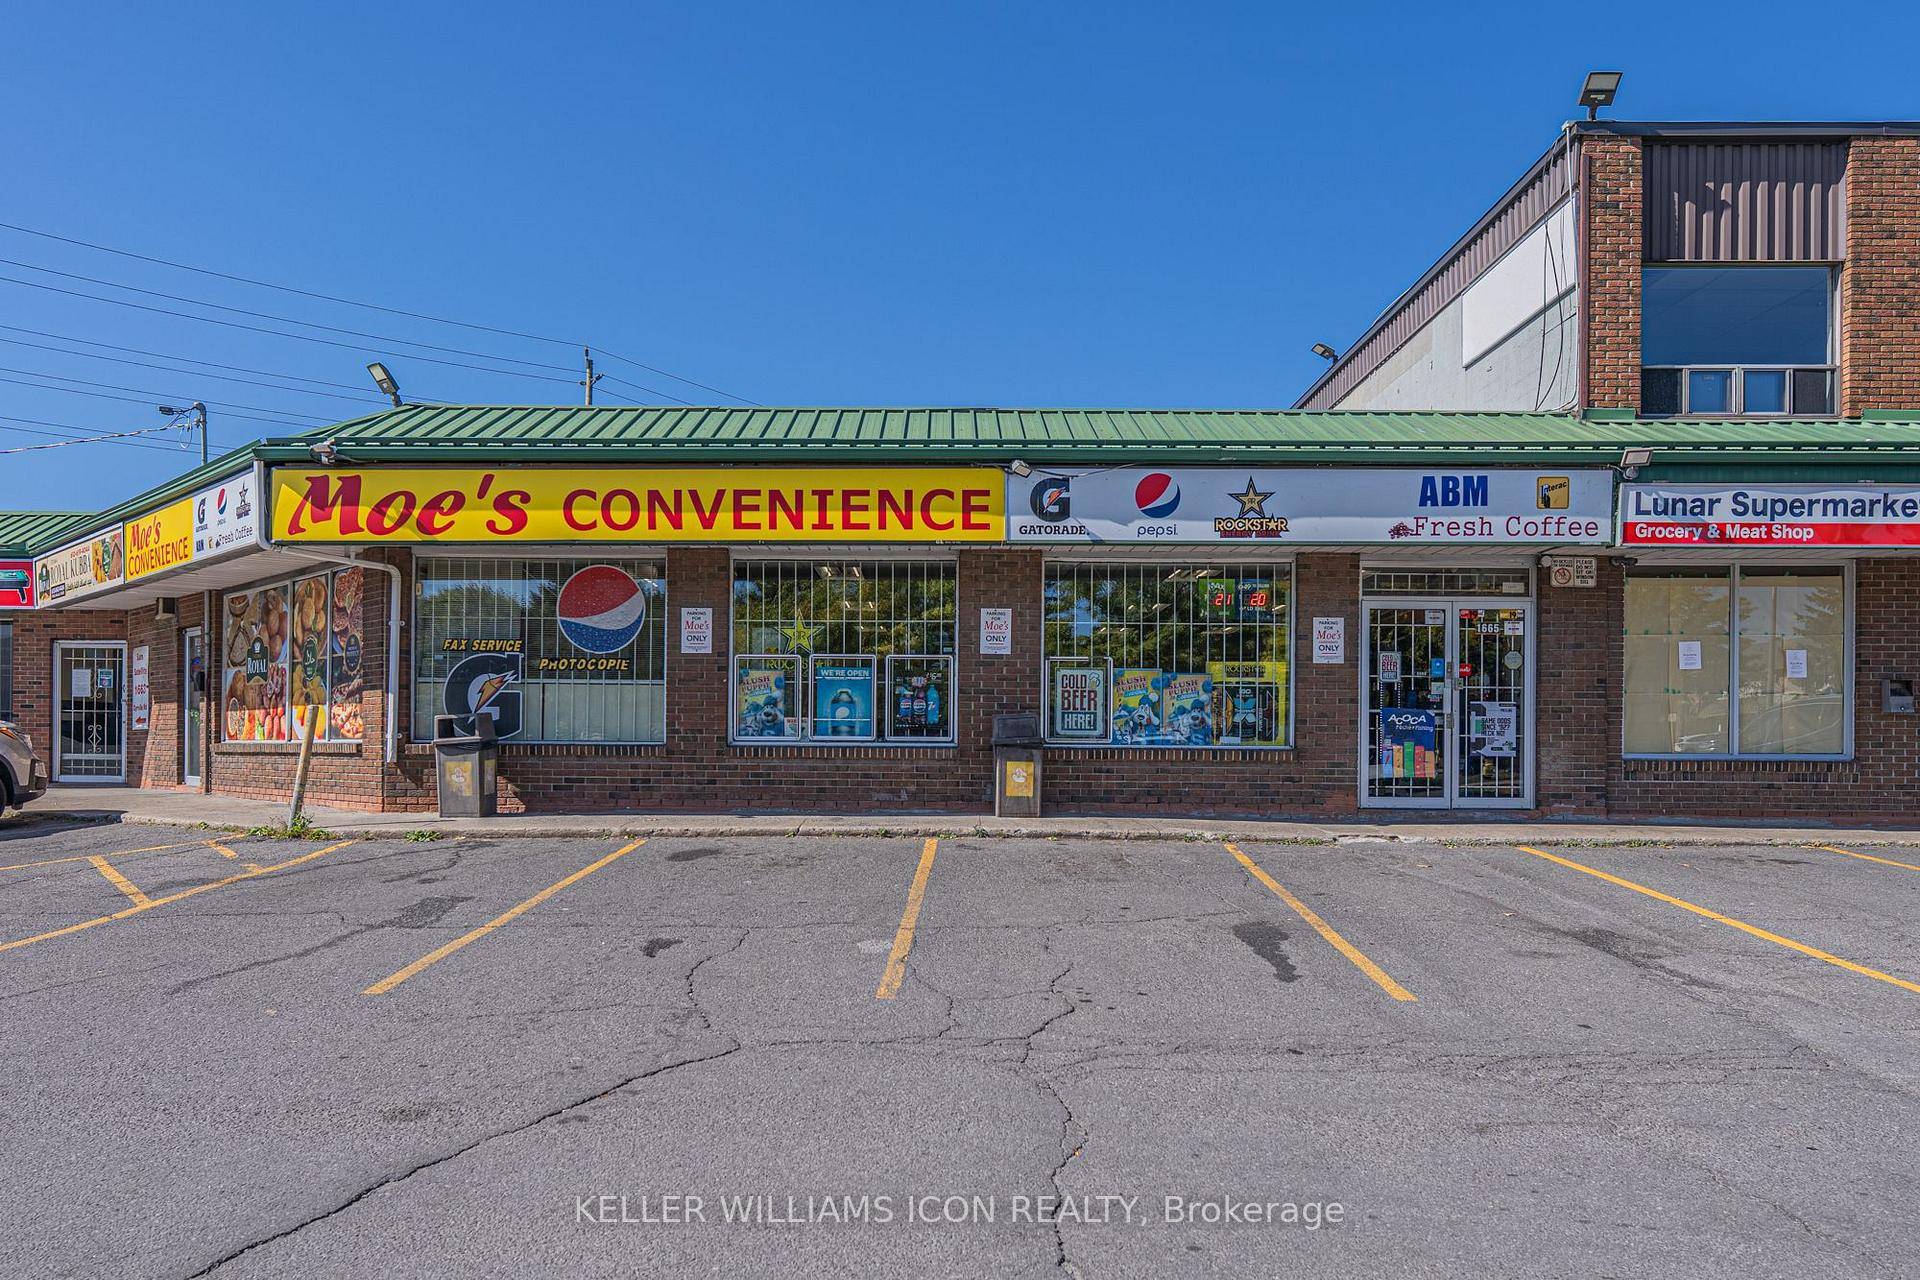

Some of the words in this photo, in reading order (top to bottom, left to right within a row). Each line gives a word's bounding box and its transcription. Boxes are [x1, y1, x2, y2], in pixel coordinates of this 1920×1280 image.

[1418, 475, 1488, 507] ABM
[288, 474, 532, 536] Moe's
[563, 488, 991, 531] CONVENIENCE
[1635, 491, 1721, 517] Lunar
[1731, 491, 1920, 521] Supermarke
[1019, 525, 1087, 535] GATORADE
[1137, 523, 1177, 539] pepsi
[1413, 516, 1494, 537] Fresh
[1505, 515, 1599, 537] Coffee
[1635, 523, 1702, 541] Grocery
[1707, 524, 1721, 539] &
[1725, 524, 1768, 539] Meat
[1771, 524, 1814, 541] Shop
[129, 516, 161, 554] Moe's
[219, 533, 234, 546] Fresh
[234, 525, 253, 541] Coffee
[128, 536, 189, 576] CONVENIENCE
[1250, 593, 1266, 606] 20
[685, 620, 709, 630] Moe's
[984, 620, 1008, 630] Moe's
[1477, 623, 1500, 633] 1665
[686, 634, 708, 642] ONLY
[1316, 630, 1341, 640] Moe's
[443, 639, 468, 651] FAX
[472, 639, 522, 652] SERVICE
[1318, 644, 1340, 652] ONLY
[247, 657, 267, 674] ROYAL
[539, 657, 630, 671] PHOTOCOPIE
[820, 668, 844, 677] WE'RE
[847, 668, 870, 677] OPEN
[1061, 673, 1088, 689] COLD
[1116, 675, 1147, 686] SLUSH
[1168, 679, 1199, 690] SLUSH
[1061, 689, 1098, 711] BEER
[1063, 713, 1095, 730] HERE!
[1387, 714, 1427, 724] ACOCA
